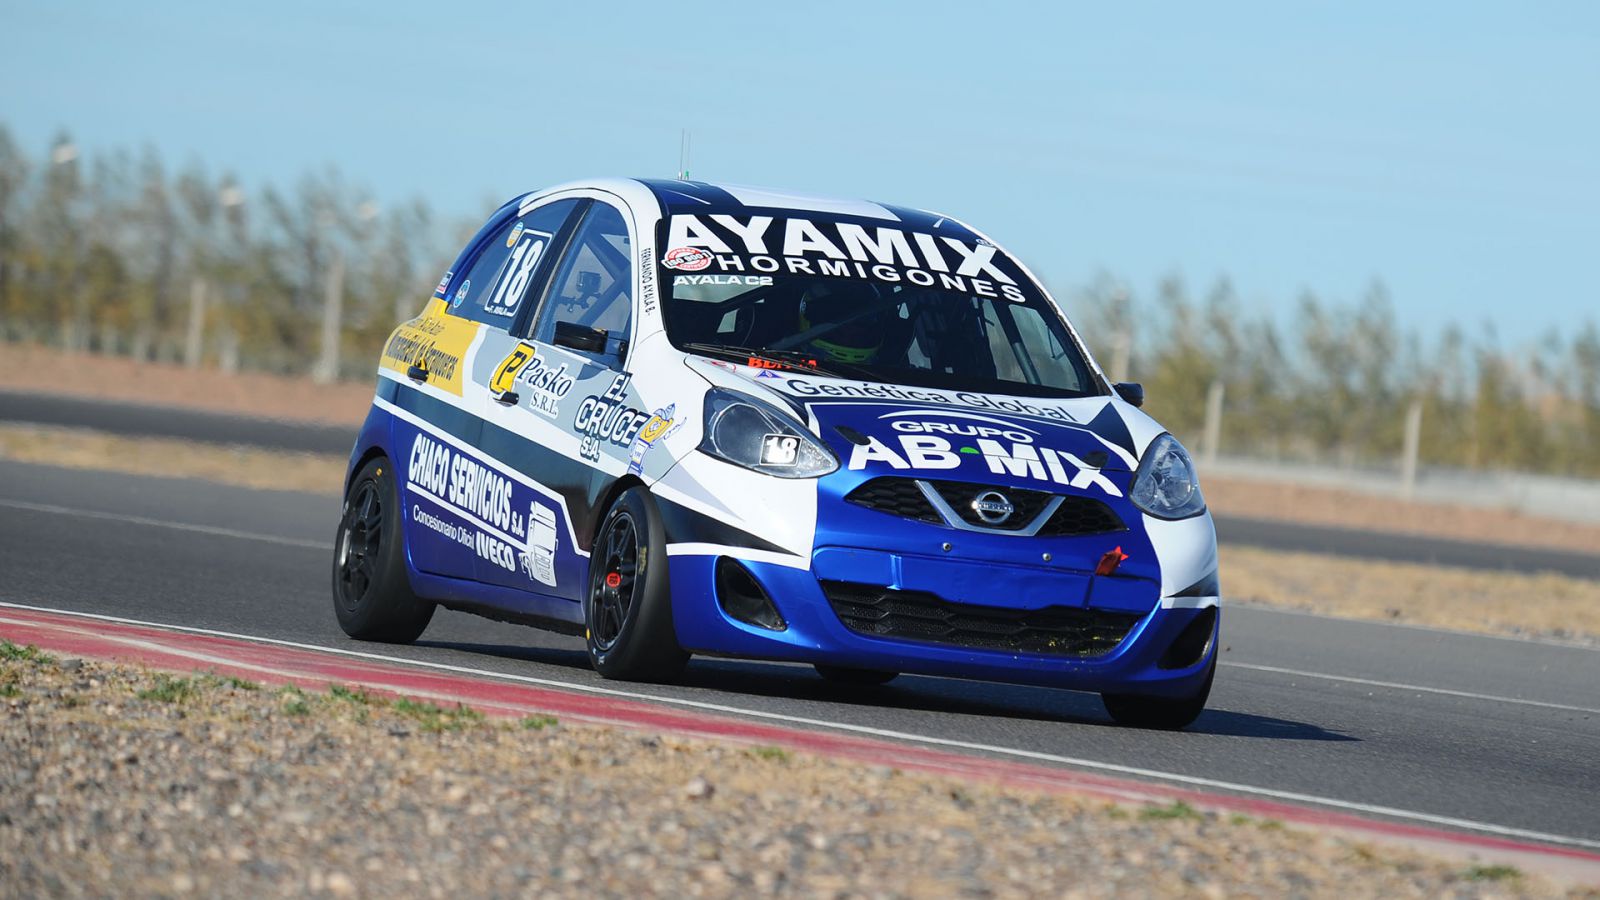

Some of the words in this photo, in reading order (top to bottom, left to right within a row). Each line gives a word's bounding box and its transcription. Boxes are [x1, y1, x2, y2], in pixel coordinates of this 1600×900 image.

[667, 213, 1019, 286] AYAMIX
[493, 238, 544, 307] 18
[673, 275, 742, 286] AYALA
[744, 275, 774, 286] C2
[716, 254, 1027, 304] HORMIGONES
[643, 284, 655, 307] AYALA
[517, 357, 572, 398] Pasko
[604, 373, 632, 402] EL
[530, 391, 557, 416] S.R.L.
[786, 379, 952, 404] Genética
[956, 393, 1077, 421] Global
[575, 397, 649, 449] CRUCE
[891, 420, 1034, 444] GRUPO
[766, 436, 798, 464] 18
[408, 433, 451, 498] CHACO
[449, 453, 514, 532] SERVICIOS
[413, 504, 457, 541] Concesionario
[457, 526, 475, 551] Oficial
[475, 530, 516, 573] IVECO
